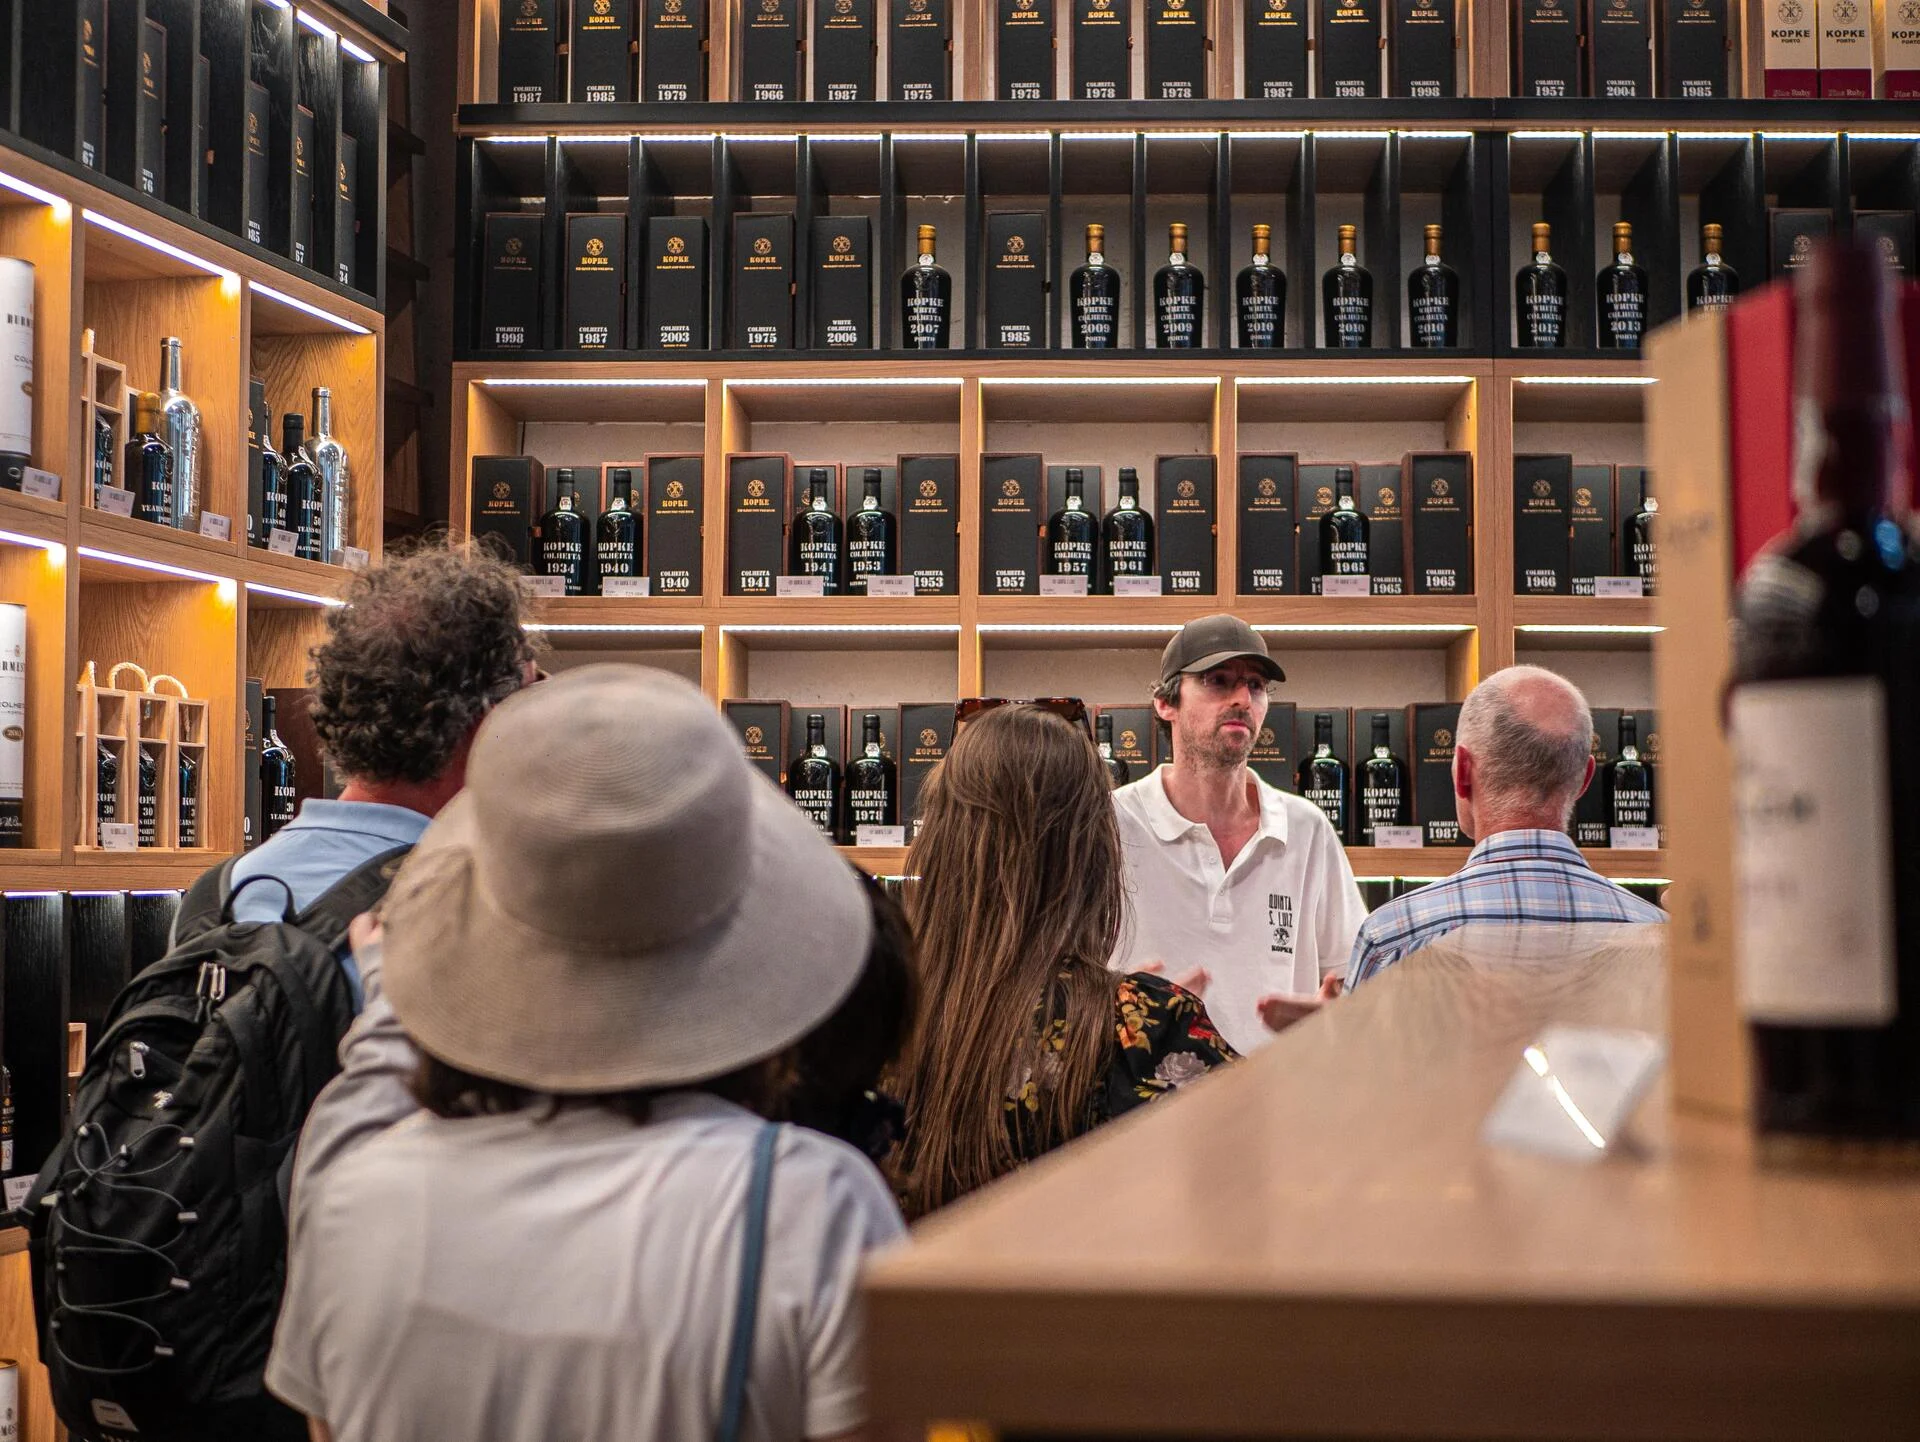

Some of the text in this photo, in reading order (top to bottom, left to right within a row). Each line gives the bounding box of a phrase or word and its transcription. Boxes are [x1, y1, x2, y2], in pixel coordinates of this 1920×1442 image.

[658, 91, 687, 100] 1979
[754, 90, 783, 100] 1966
[828, 90, 857, 100] 1987
[903, 90, 933, 100] 1975
[1011, 89, 1040, 99] 1978
[1086, 88, 1115, 99] 1978
[1162, 88, 1191, 98] 1978
[1264, 88, 1293, 98] 1987
[1335, 87, 1364, 97] 1998
[1536, 86, 1564, 96] 1957
[1607, 87, 1635, 96] 2004
[1683, 87, 1712, 96] 1985
[1792, 89, 1811, 97] Ruby
[513, 93, 541, 103] 1987
[586, 92, 615, 102] 1985
[907, 298, 943, 306] KOPKE
[1077, 298, 1113, 306] KOPKE
[1160, 297, 1196, 306] KOPKE
[1243, 297, 1278, 305] KOPKE
[1333, 298, 1368, 306] KOPKE
[1413, 297, 1448, 306] KOPKE
[1526, 295, 1562, 305] KOPKE
[1606, 293, 1644, 303] KOPKE
[911, 324, 939, 334] 2007
[1081, 323, 1110, 333] 2009
[1163, 323, 1192, 333] 2009
[1247, 322, 1274, 332] 2010
[1339, 323, 1364, 333] 2010
[1418, 324, 1444, 333] 2010
[1530, 323, 1559, 333] 2012
[1611, 322, 1640, 331] 2013
[495, 333, 524, 343] 1998
[579, 333, 608, 343] 1987
[661, 332, 689, 342] 2003
[748, 333, 777, 343] 1975
[828, 333, 857, 343] 2006
[1001, 332, 1030, 342] 1985
[544, 542, 581, 552] KOPKE
[598, 542, 633, 551] KOPKE
[801, 543, 836, 551] KOPKE
[850, 541, 885, 550] KOPKE
[1054, 542, 1091, 552] KOPKE
[1110, 541, 1146, 551] KOPKE
[1331, 543, 1367, 551] KOPKE
[547, 563, 574, 573] 1934
[600, 563, 629, 573] 1940
[805, 562, 833, 572] 1941
[853, 561, 880, 571] 1953
[1058, 563, 1087, 572] 1957
[1114, 561, 1142, 571] 1961
[1337, 562, 1364, 572] 1965
[660, 578, 689, 588] 1940
[741, 577, 770, 587] 1941
[914, 577, 943, 587] 1953
[996, 577, 1025, 587] 1957
[1172, 578, 1200, 588] 1961
[1253, 576, 1282, 587] 1965
[1426, 576, 1455, 587] 1965
[1526, 577, 1556, 587] 1966
[1373, 584, 1401, 593] 1965
[796, 791, 833, 799] KOPKE
[851, 790, 888, 799] KOPKE
[1305, 790, 1342, 799] KOPKE
[1364, 788, 1400, 797] KOPKE
[1615, 791, 1650, 800] KOPKE
[104, 805, 113, 814] 30
[143, 808, 153, 816] 30
[1368, 809, 1396, 818] 1987
[855, 810, 883, 820] 1978
[1618, 810, 1647, 821] 1998
[1429, 828, 1458, 838] 1987
[1269, 893, 1292, 911] QUINTA
[1278, 912, 1292, 927] LUIZ
[1272, 945, 1292, 954] KOPKE
